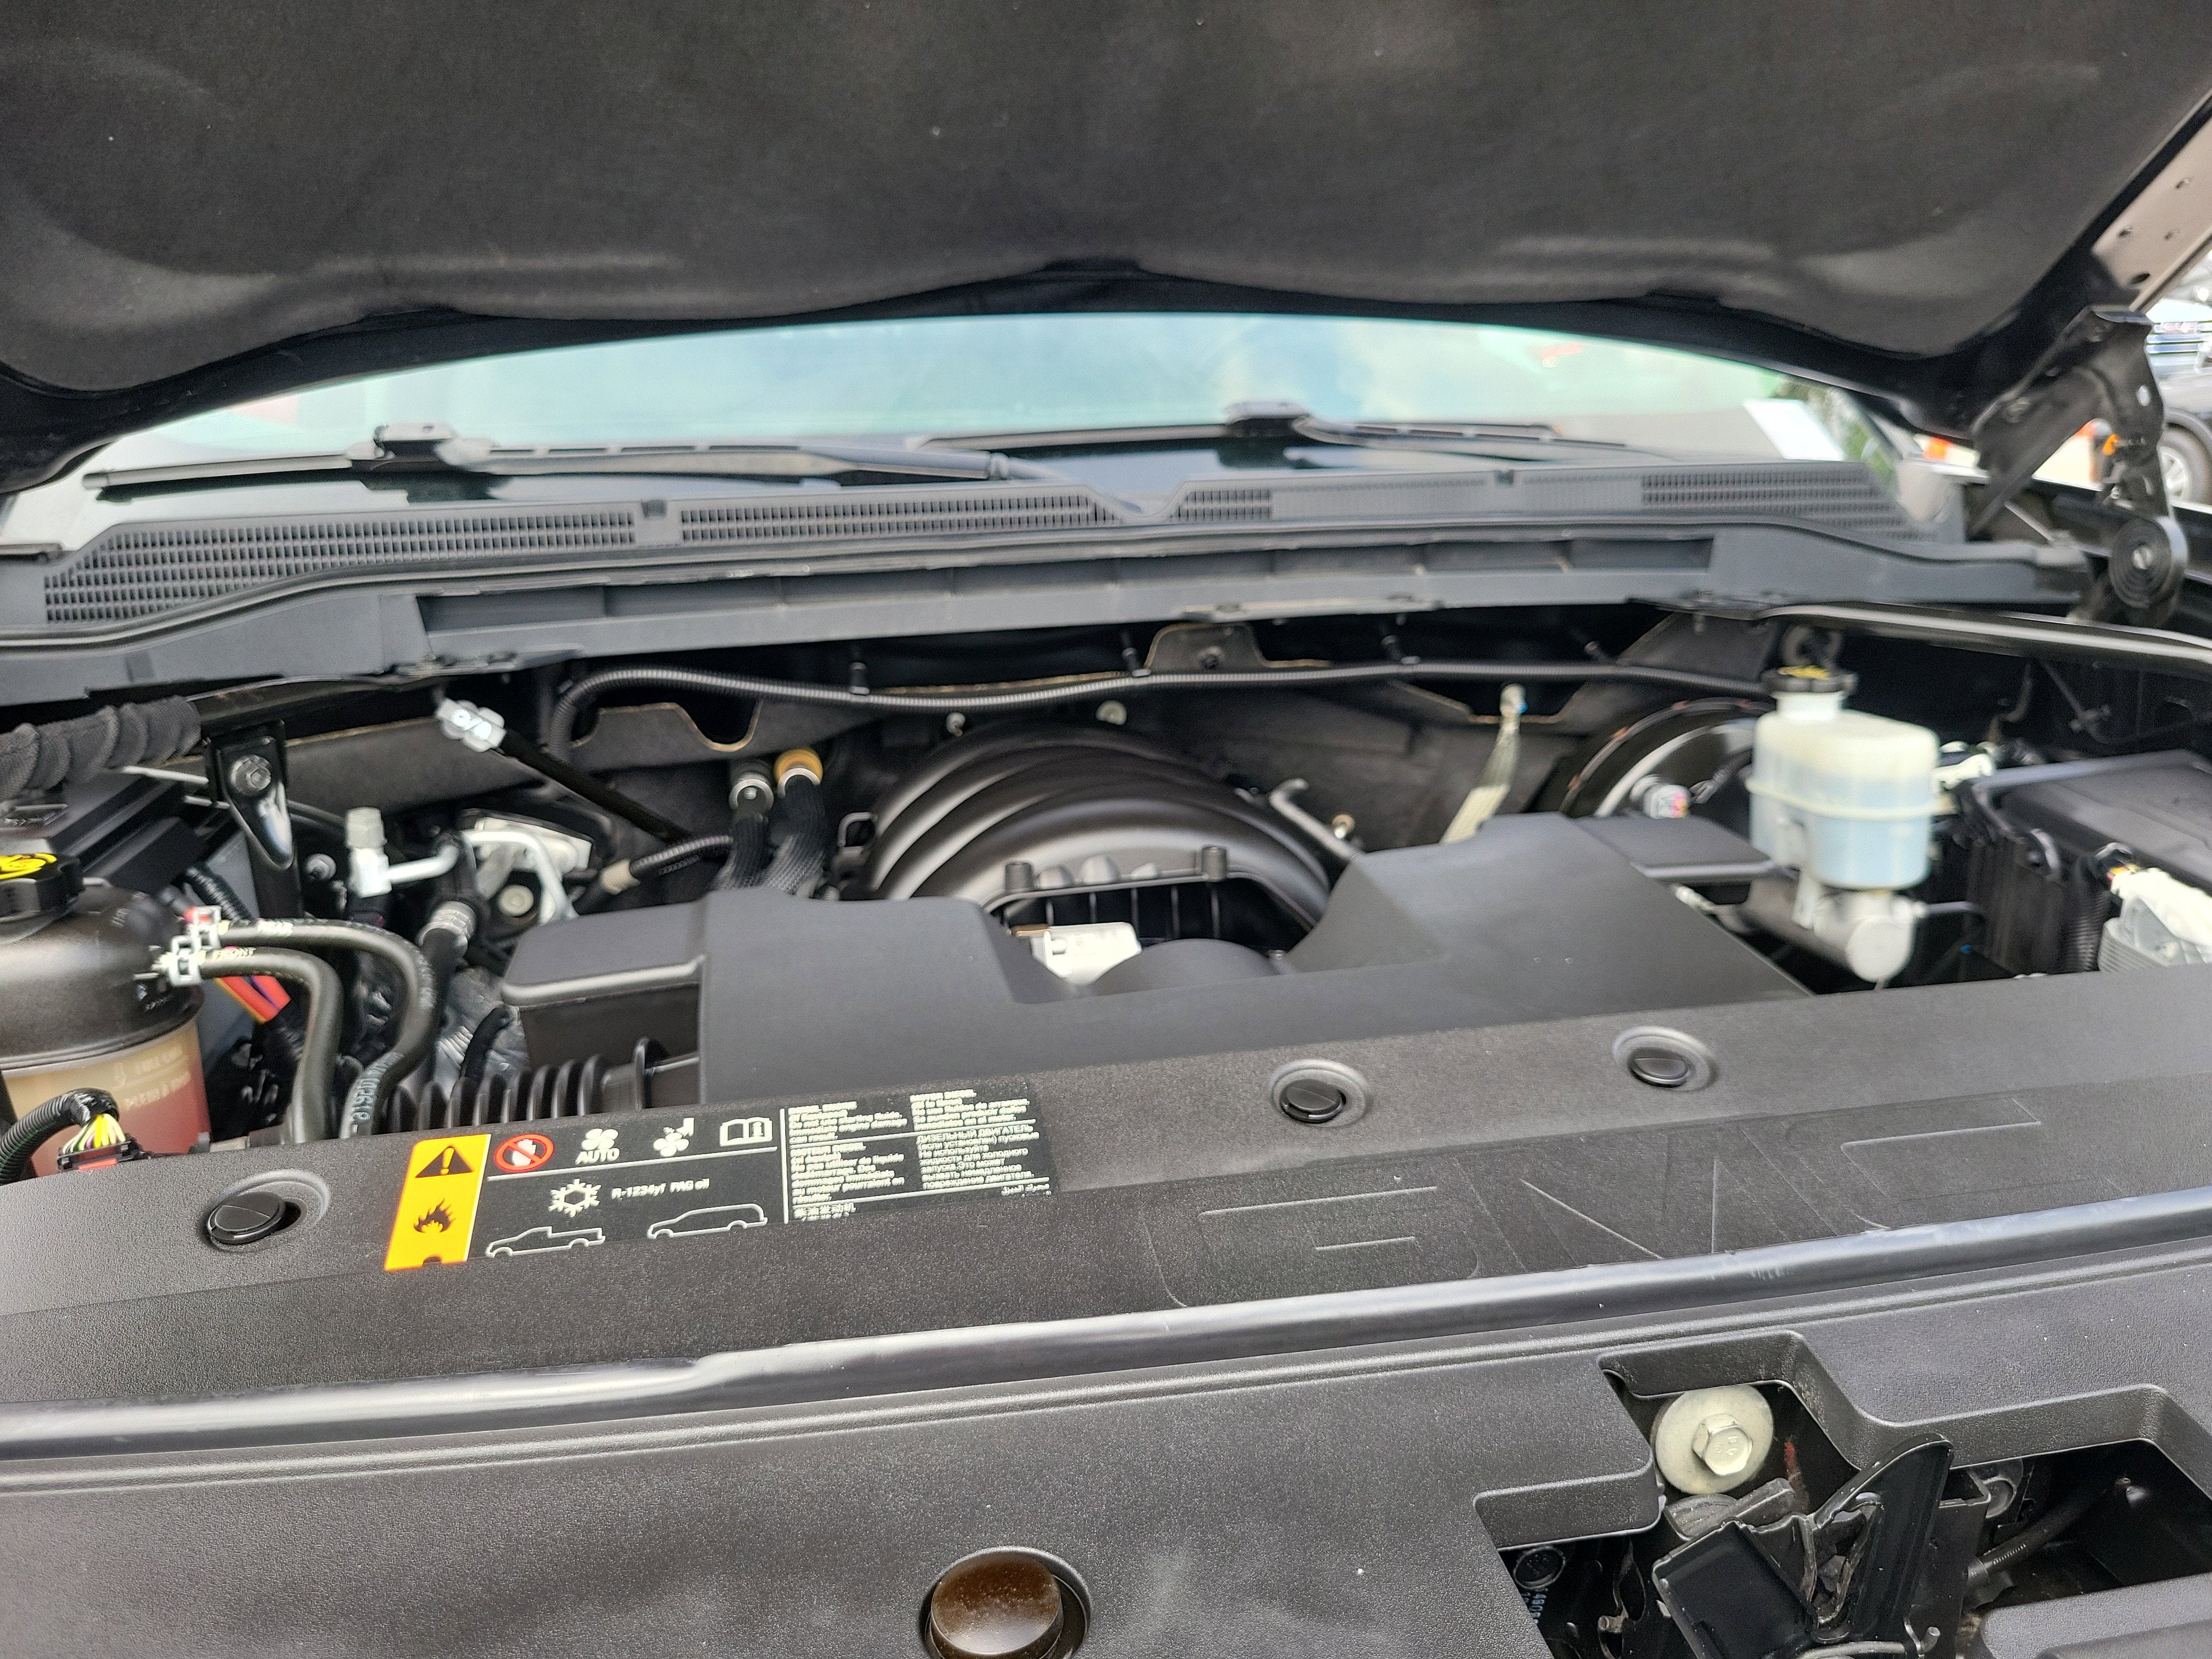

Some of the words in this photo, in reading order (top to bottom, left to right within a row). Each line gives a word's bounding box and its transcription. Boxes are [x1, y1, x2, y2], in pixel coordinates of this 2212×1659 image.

[978, 1124, 1034, 1138] ДВИГАТЕЛЬ
[575, 1148, 620, 1165] AUTO
[611, 1183, 667, 1200] R-1234yf
[670, 1180, 694, 1193] PAG
[694, 1178, 710, 1190] oil
